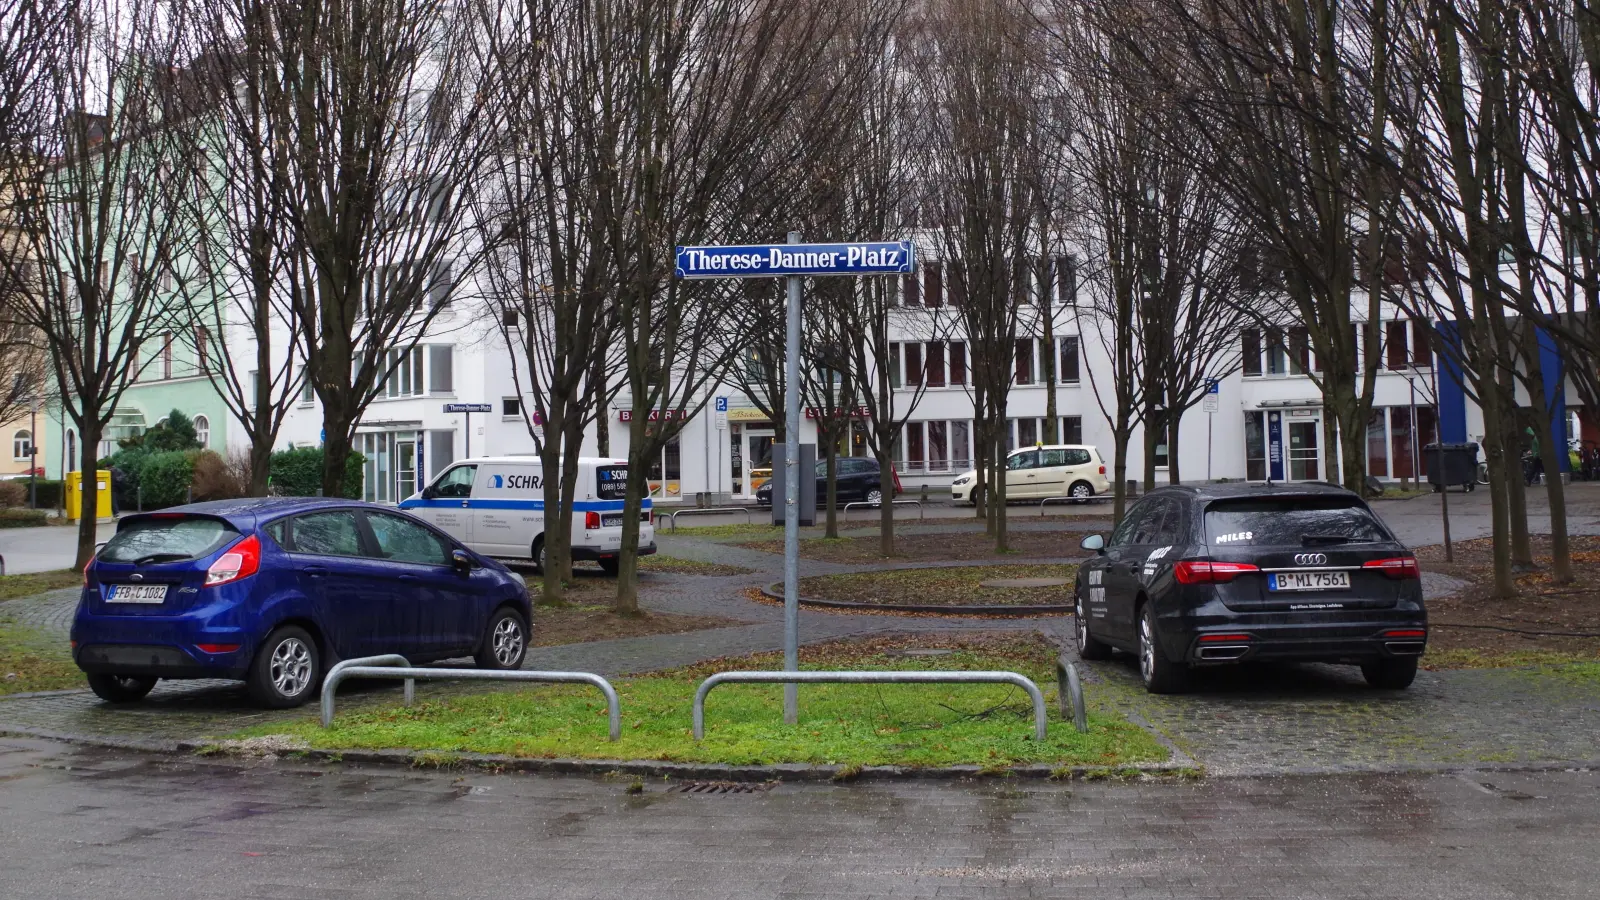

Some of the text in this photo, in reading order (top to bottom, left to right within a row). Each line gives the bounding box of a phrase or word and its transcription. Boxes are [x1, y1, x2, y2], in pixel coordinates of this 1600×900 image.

[686, 247, 899, 271] Therese-Danner-Platz
[1215, 531, 1253, 544] MILES
[142, 587, 166, 599] 1082
